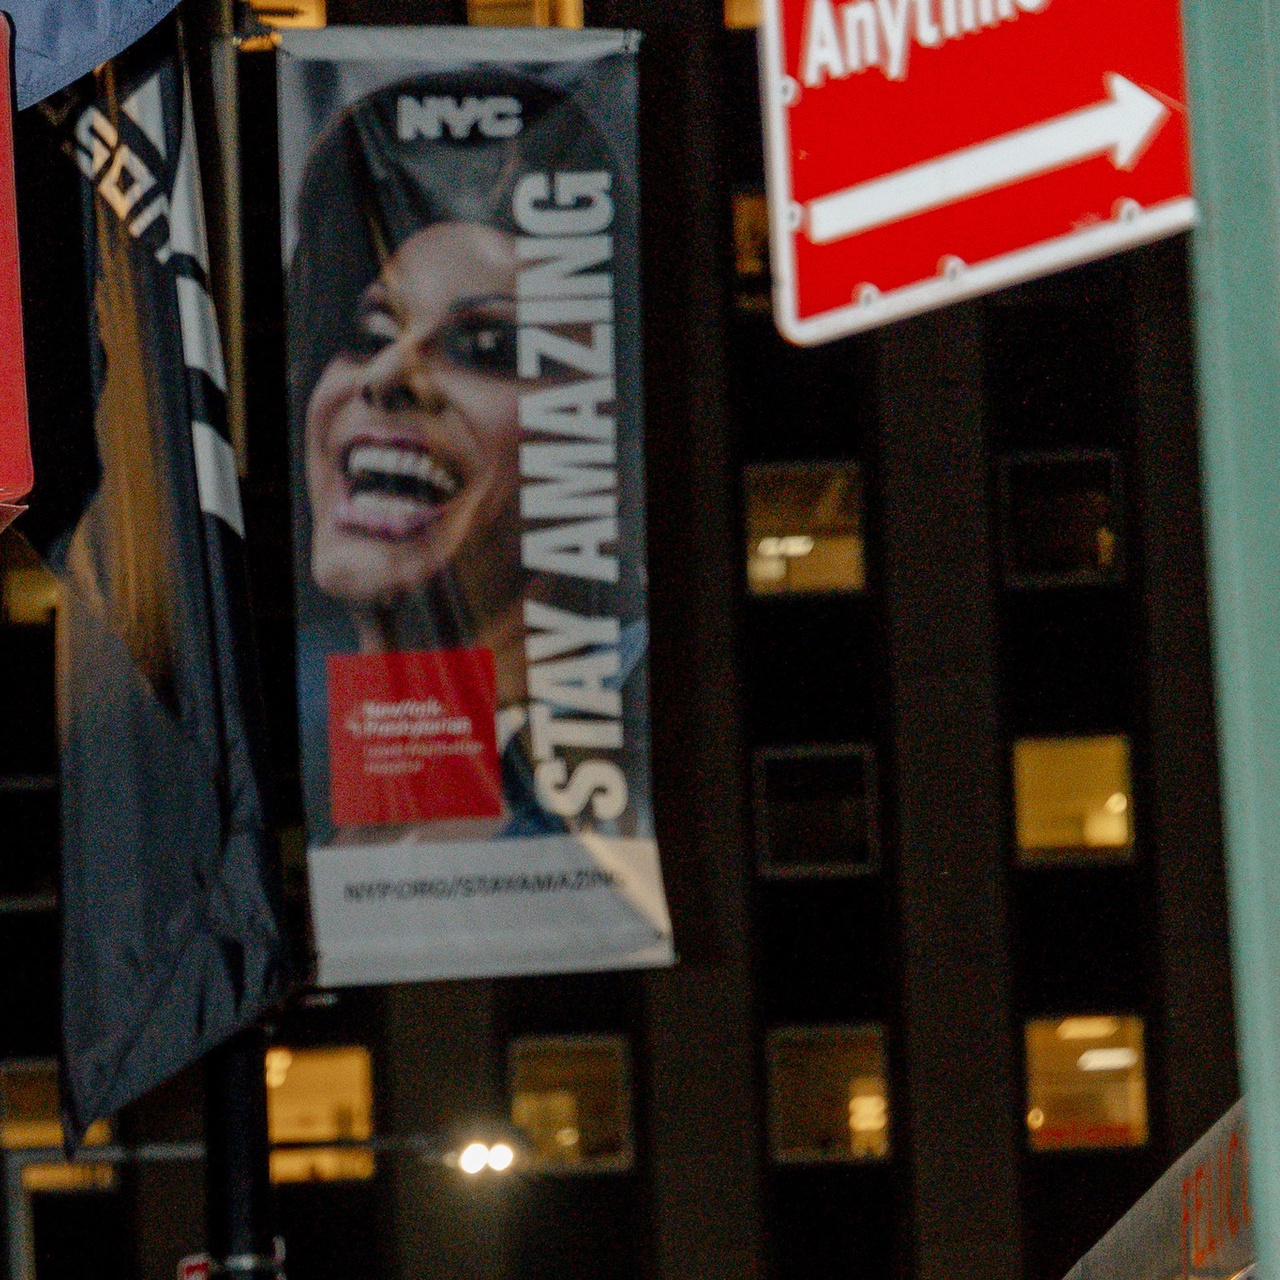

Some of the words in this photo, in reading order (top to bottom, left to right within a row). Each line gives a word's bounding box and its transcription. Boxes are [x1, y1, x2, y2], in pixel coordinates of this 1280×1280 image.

[397, 95, 523, 140] NYC
[803, 0, 1046, 87] Anyt
[514, 169, 619, 584] AMAZING
[524, 599, 630, 821] STAY
